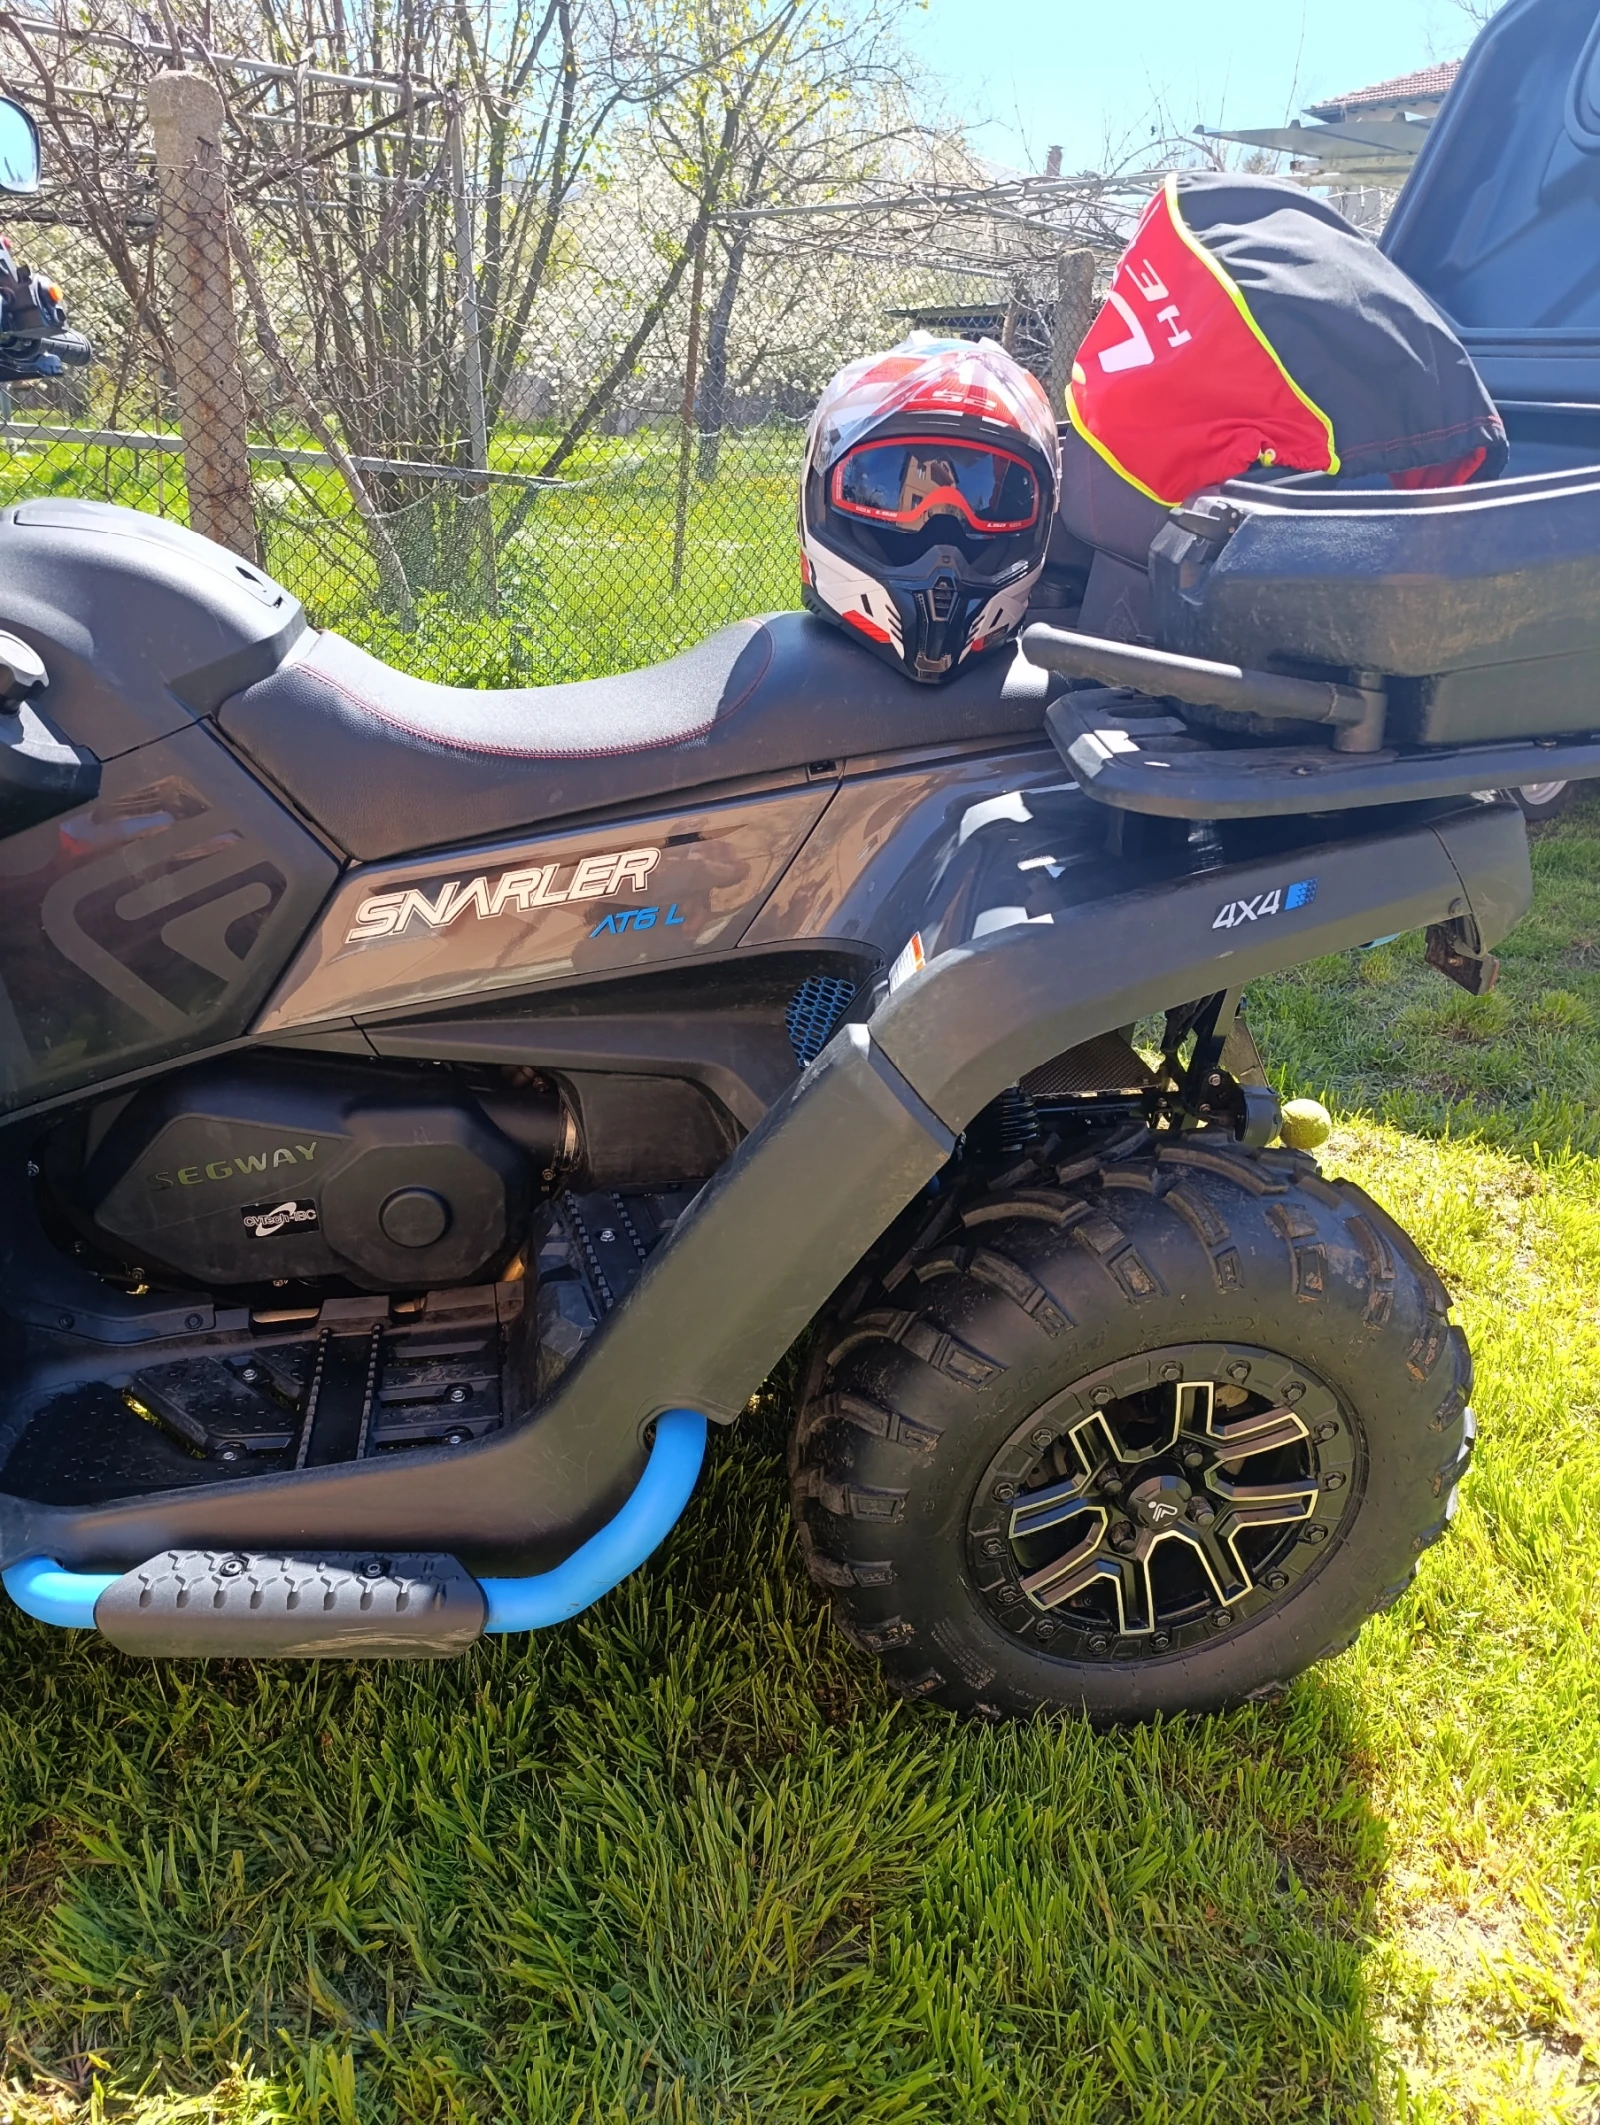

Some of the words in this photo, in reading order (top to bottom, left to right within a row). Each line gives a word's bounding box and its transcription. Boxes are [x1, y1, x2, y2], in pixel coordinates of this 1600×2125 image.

[345, 847, 661, 943] SNARLER
[589, 906, 660, 938] AT6
[665, 903, 685, 925] L
[148, 1142, 317, 1191] SEGWAY
